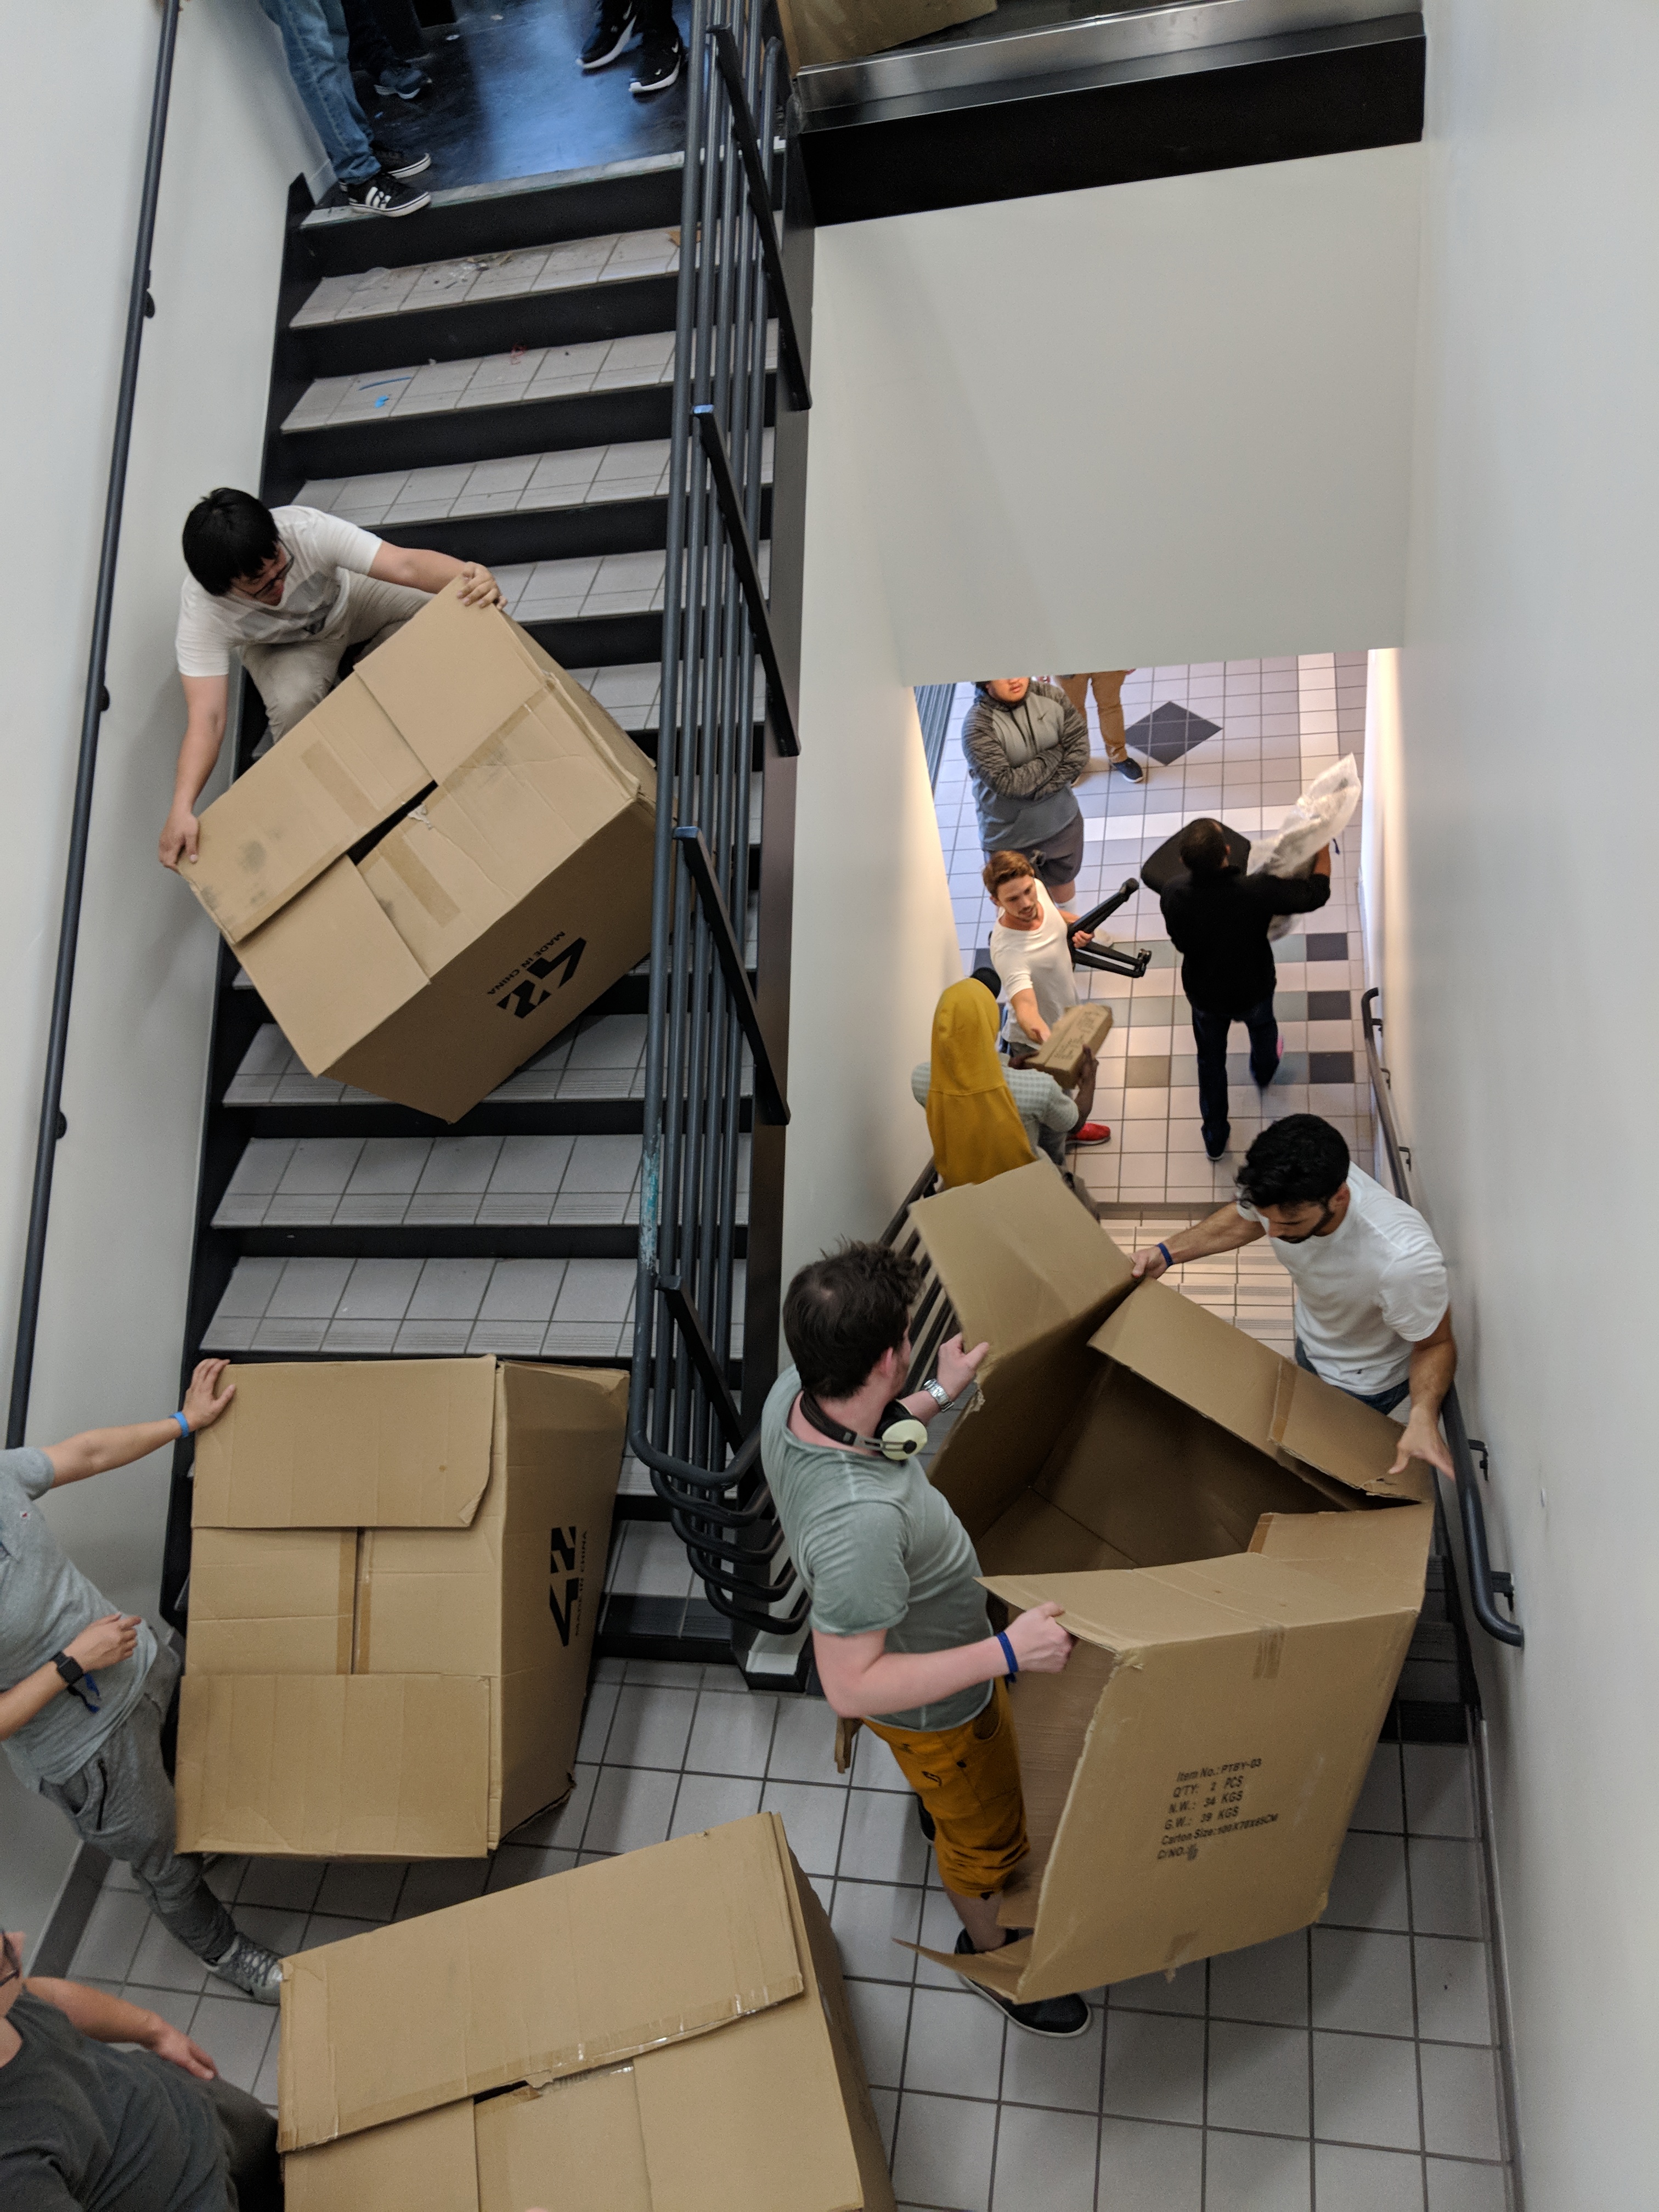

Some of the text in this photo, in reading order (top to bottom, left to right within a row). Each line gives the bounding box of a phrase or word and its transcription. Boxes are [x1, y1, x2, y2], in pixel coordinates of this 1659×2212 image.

[487, 931, 565, 994] MADE IN CHINA
[1177, 1771, 1199, 1782] Item
[1224, 1775, 1244, 1789] PCS
[1221, 1791, 1243, 1804] KGS
[1218, 1806, 1239, 1820] KGS
[1161, 1832, 1192, 1845] Carton
